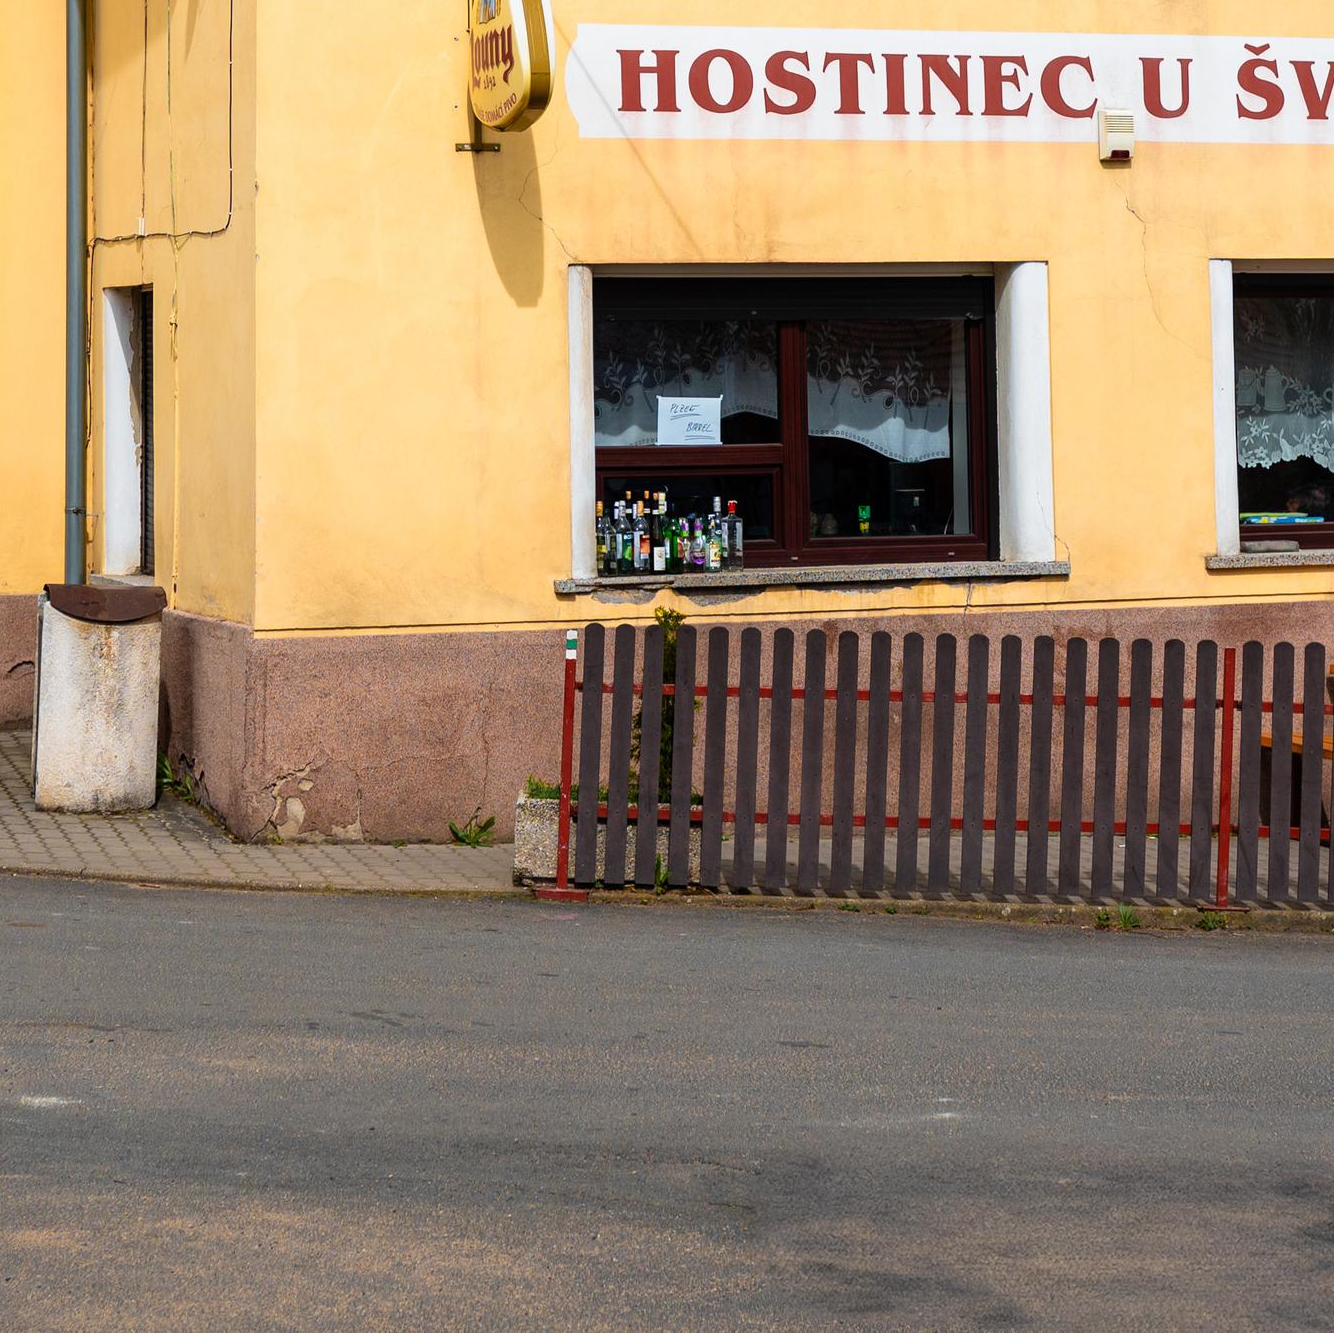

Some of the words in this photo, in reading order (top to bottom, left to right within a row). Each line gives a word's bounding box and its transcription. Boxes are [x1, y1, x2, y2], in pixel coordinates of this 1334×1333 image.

[503, 92, 517, 114] PIVO
[616, 49, 1098, 119] HOSTINEC
[1140, 58, 1192, 119] U
